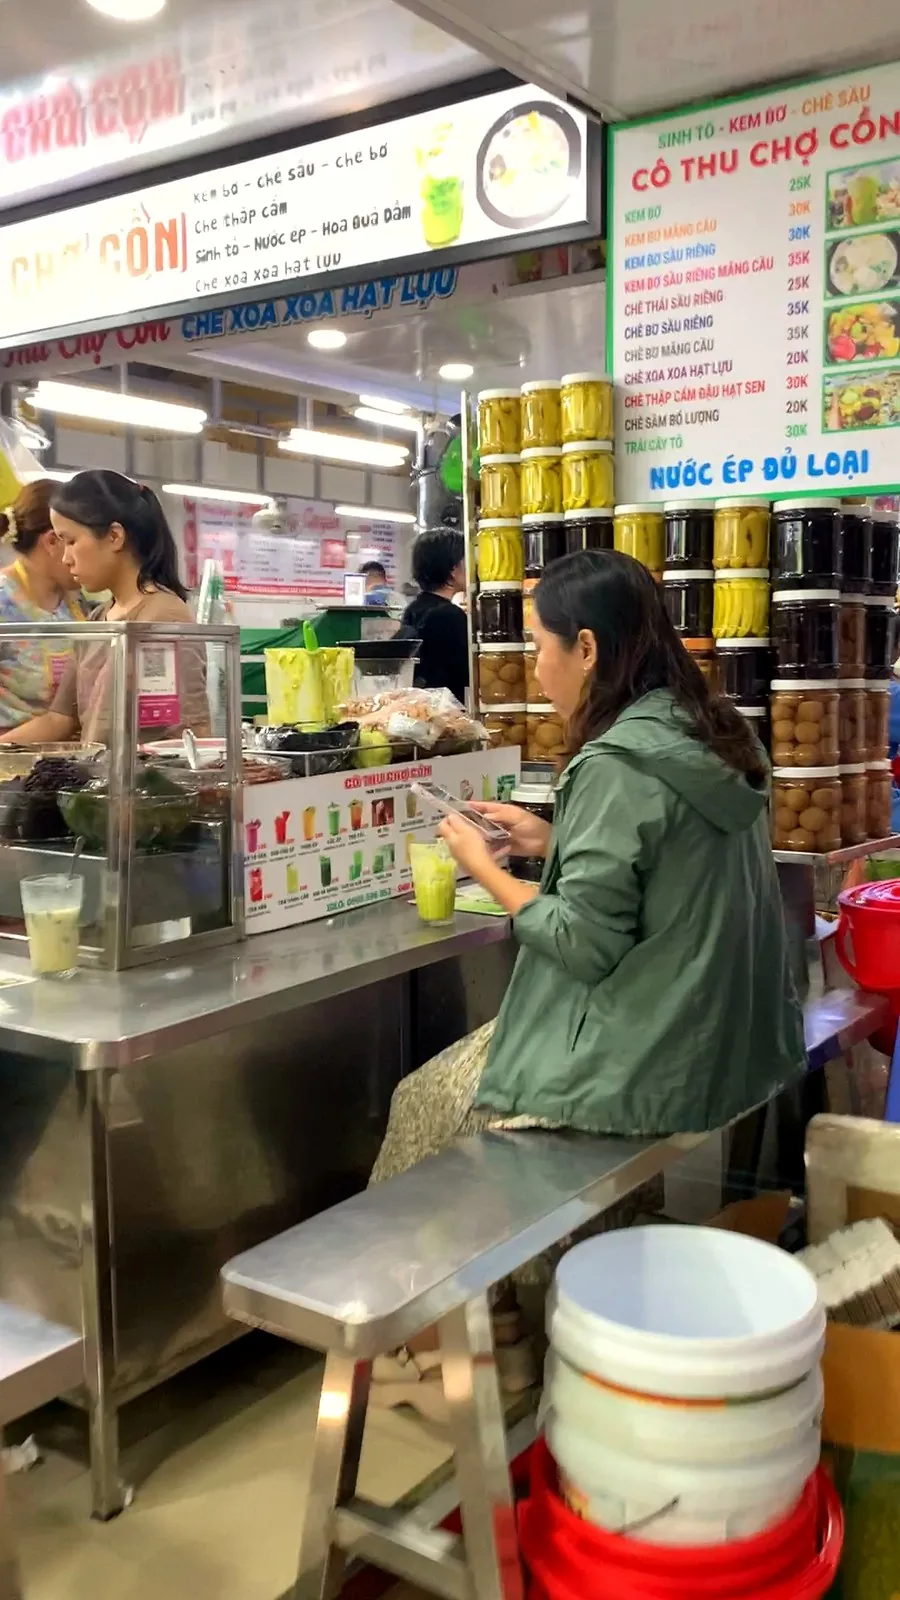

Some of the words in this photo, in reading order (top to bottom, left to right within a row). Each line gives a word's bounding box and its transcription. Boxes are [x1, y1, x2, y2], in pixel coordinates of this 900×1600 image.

[658, 127, 692, 149] SINH
[729, 112, 761, 134] KEM
[632, 157, 671, 192] CÔ
[681, 149, 738, 183] THU
[749, 127, 818, 167] CHỢ
[624, 207, 645, 224] KEM
[788, 174, 811, 192] 25K
[624, 232, 645, 248] KEM
[788, 200, 810, 217] 30K
[624, 255, 645, 270] KEM
[788, 224, 811, 241] 30K
[253, 265, 278, 281] xoa
[624, 278, 645, 294] KEM
[787, 250, 810, 267] 35K
[230, 299, 278, 334] XOA
[284, 288, 336, 323] XOA
[645, 296, 669, 314] THÁI
[787, 274, 810, 291] 25K
[683, 314, 713, 331] RIÊNG
[787, 300, 809, 316] 35K
[787, 324, 809, 341] 35K
[645, 371, 665, 383] XOA
[667, 366, 687, 381] XOA
[690, 363, 710, 379] HẠT
[786, 349, 809, 365] 20K
[722, 382, 742, 400] HẠT
[745, 380, 765, 395] SEN
[786, 373, 809, 390] 30K
[786, 399, 808, 414] 20K
[785, 423, 808, 438] 30K
[649, 458, 713, 490] NƯỚC
[721, 454, 754, 484] ÉP
[761, 446, 797, 481] ĐỦ
[807, 448, 869, 480] LOẠI
